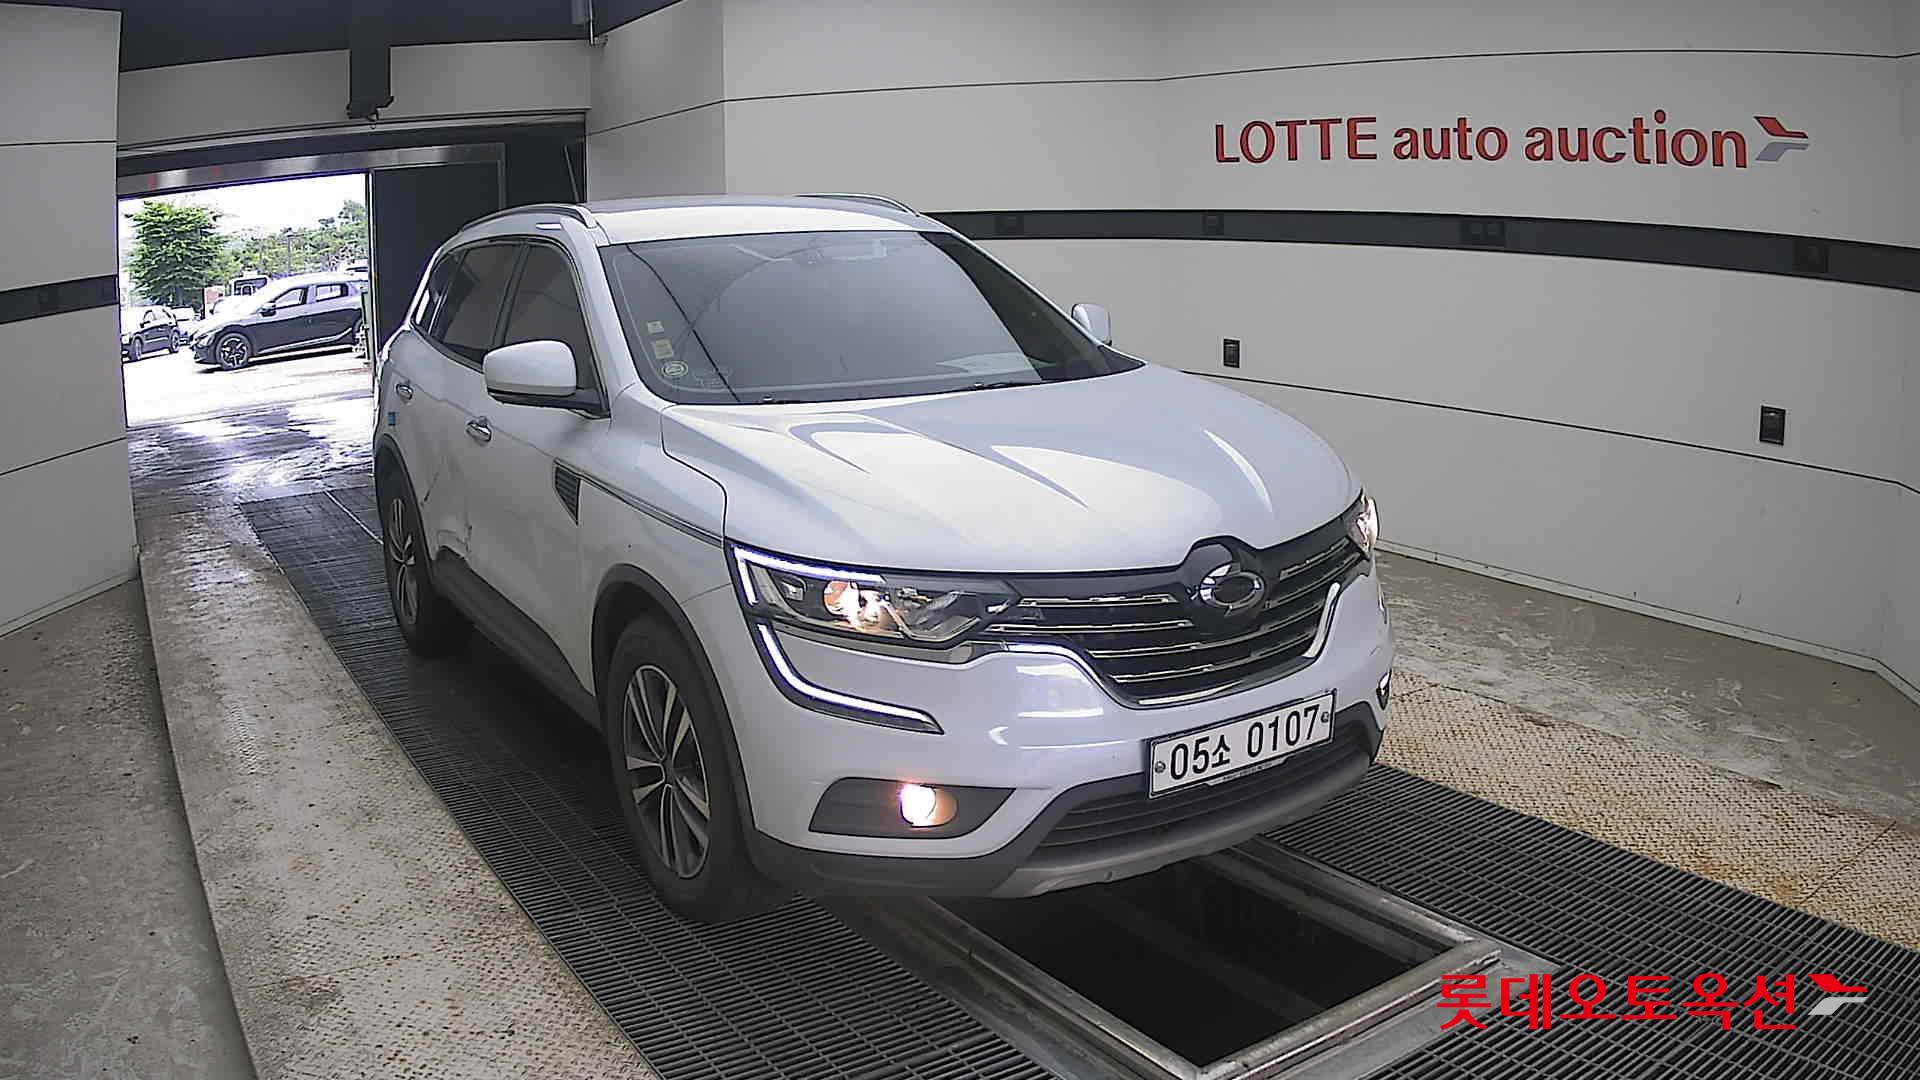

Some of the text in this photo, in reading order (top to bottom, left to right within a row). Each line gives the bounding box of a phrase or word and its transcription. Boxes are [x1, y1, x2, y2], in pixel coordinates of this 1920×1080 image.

[1215, 109, 1748, 168] LOTTE auto auction
[1170, 735, 1231, 780] 05소
[1247, 704, 1320, 758] 0107
